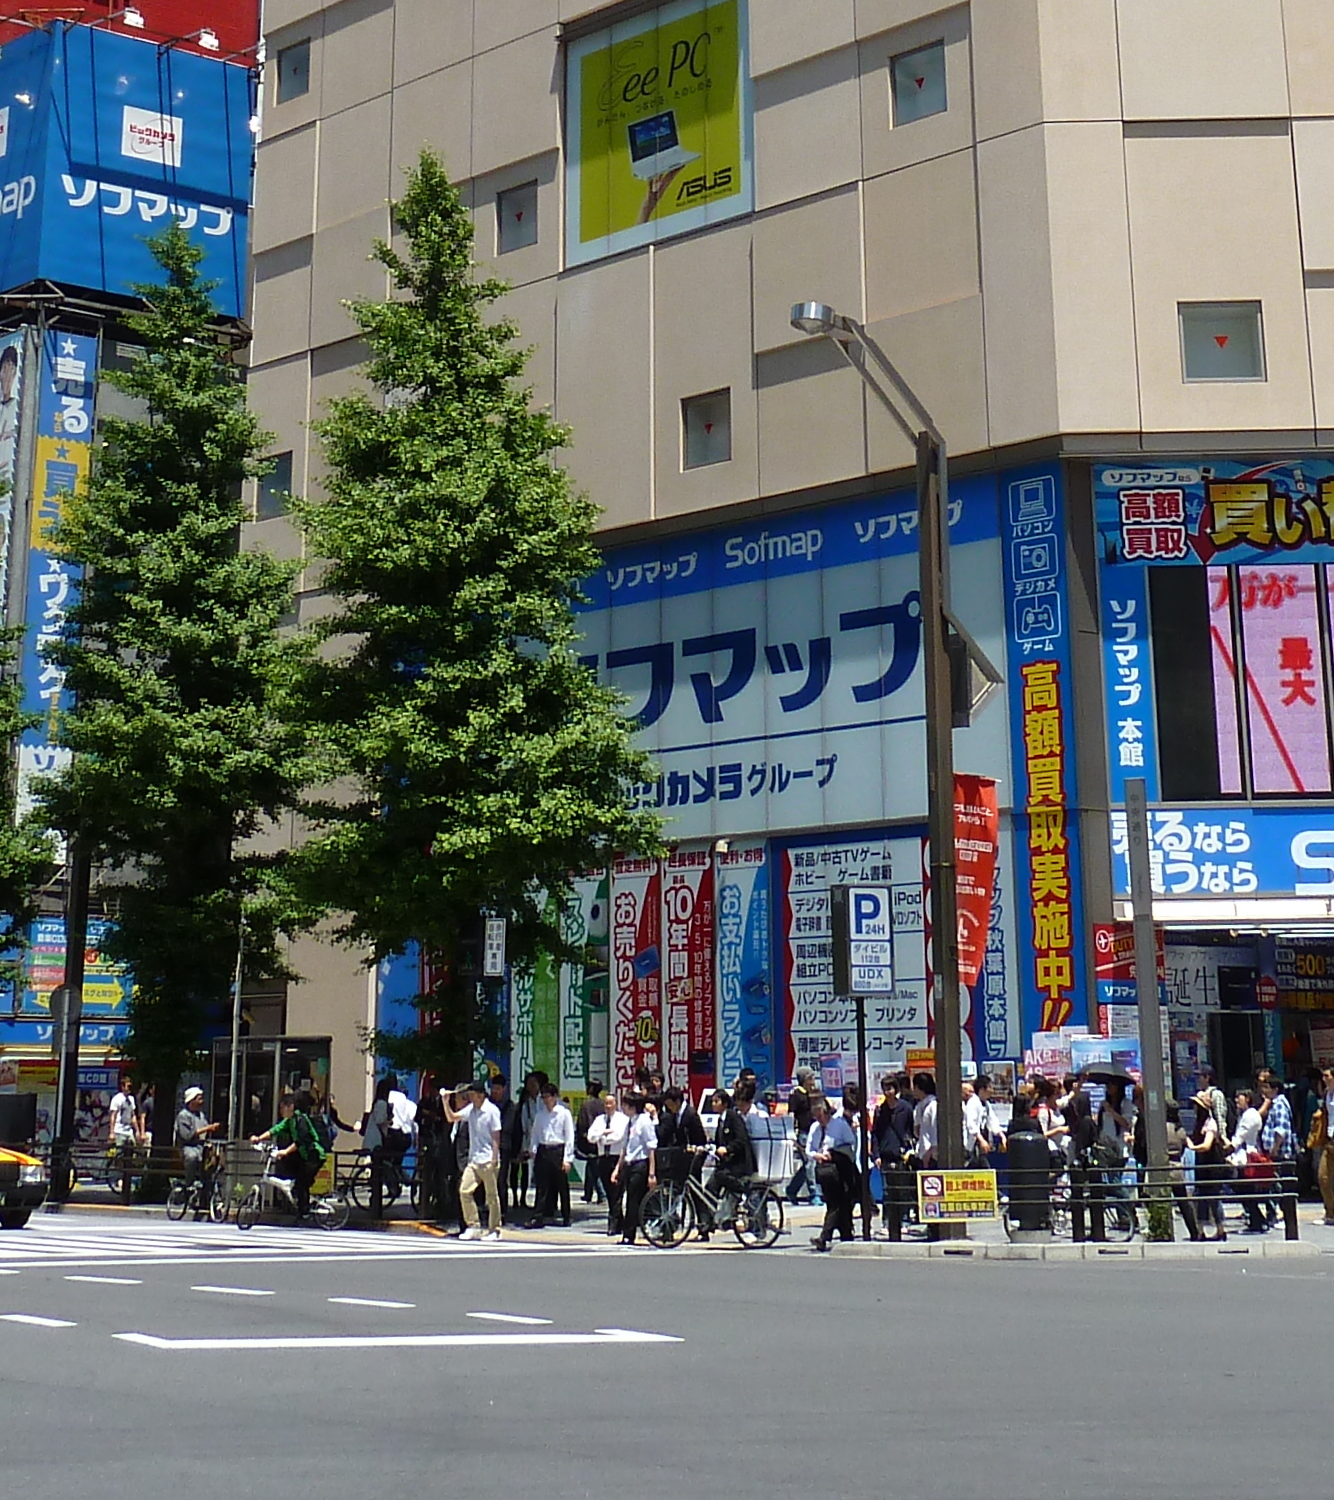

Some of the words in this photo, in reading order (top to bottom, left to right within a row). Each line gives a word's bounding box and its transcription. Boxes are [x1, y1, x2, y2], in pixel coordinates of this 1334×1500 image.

[667, 31, 712, 88] PC
[677, 167, 733, 201] ASUS
[61, 173, 234, 236] ソフマップ
[51, 356, 89, 435] 売る
[854, 499, 964, 544] ソフマプ
[1120, 488, 1185, 524] 高額
[1012, 520, 1054, 538] パソコン
[1123, 525, 1187, 560] 買取
[724, 527, 824, 568] Sofmap
[606, 550, 699, 592] ソフマップ
[1014, 578, 1057, 596] デジカメ
[576, 590, 923, 732] フマップ
[1022, 638, 1055, 655] ゲーム
[1109, 599, 1143, 708] ソフマップ
[1278, 636, 1318, 707] 最大
[1117, 716, 1145, 767] 本館
[666, 849, 709, 870] 延長保証
[794, 847, 893, 868] 新品/中古TVゲーム
[1021, 661, 1072, 1033] 高額買取実施中!!
[794, 870, 827, 887] ホビー
[854, 893, 881, 935] P
[893, 890, 923, 907] iPod
[864, 924, 885, 935] 24H
[853, 943, 888, 954] ダイビル
[1295, 953, 1327, 977] 500
[858, 968, 884, 980] UDX
[1104, 984, 1138, 998] ソフマッ
[874, 1005, 918, 1024] プリンタ
[670, 1004, 692, 1100] 長期保
[797, 1036, 851, 1054] 薄型テレビ
